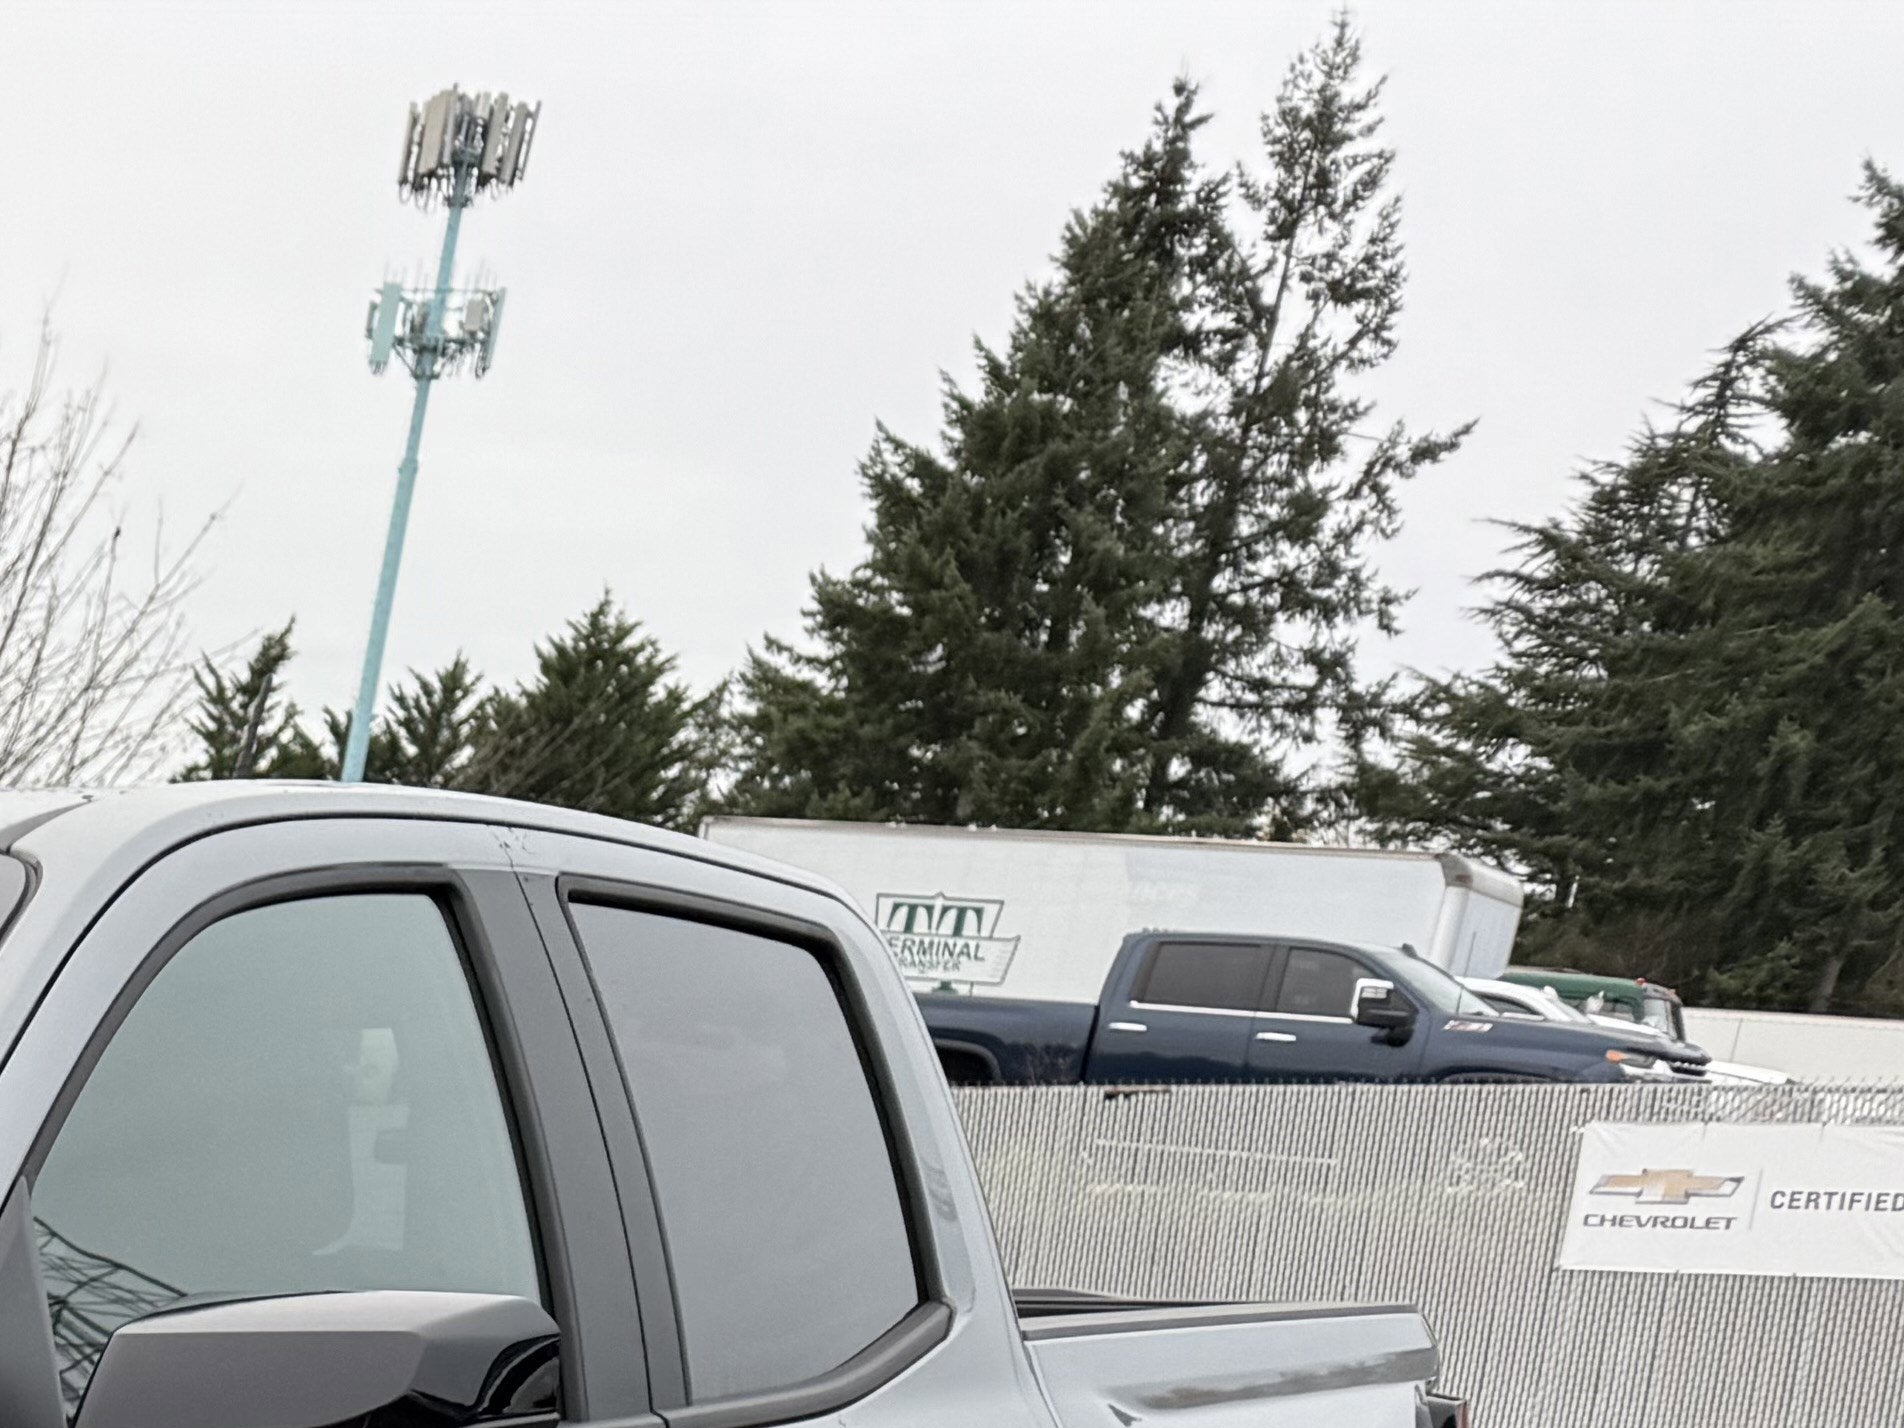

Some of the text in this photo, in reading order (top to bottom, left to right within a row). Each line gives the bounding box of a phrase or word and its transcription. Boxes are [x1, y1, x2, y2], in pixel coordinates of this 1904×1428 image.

[888, 935, 986, 961] ERMINAL
[898, 956, 961, 973] RANSFER
[1583, 1213, 1737, 1230] CHEVROLET
